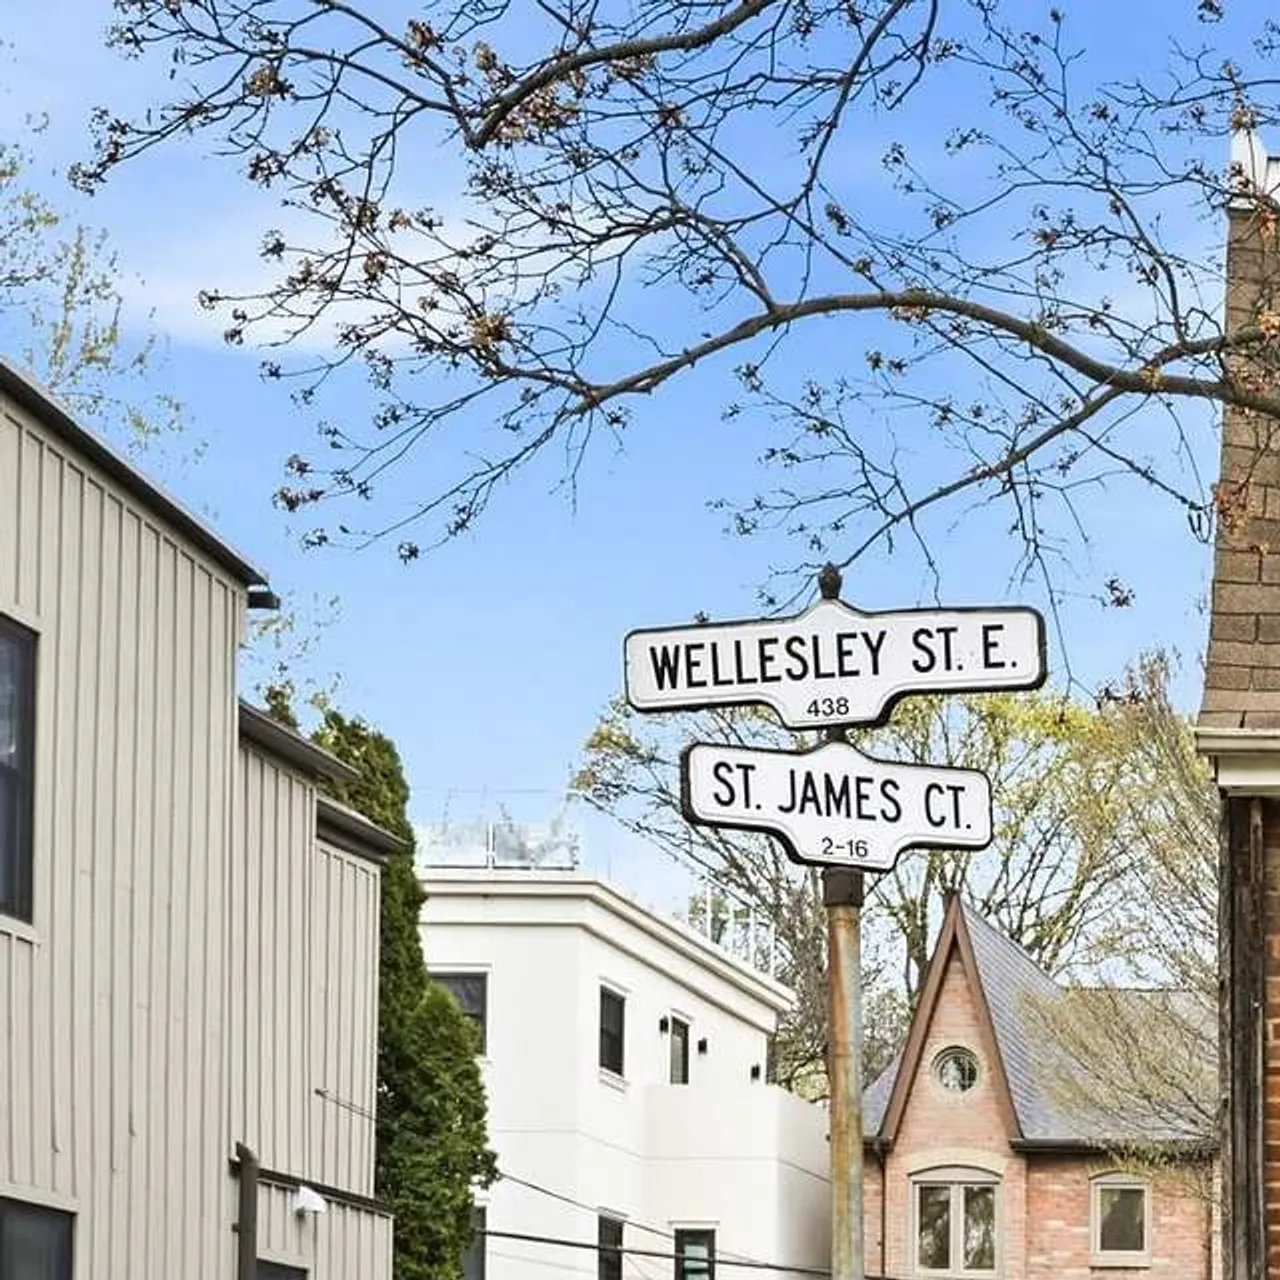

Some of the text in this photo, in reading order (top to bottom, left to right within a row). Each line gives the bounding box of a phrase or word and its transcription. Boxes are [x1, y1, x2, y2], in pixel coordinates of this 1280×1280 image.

[649, 624, 1018, 691] WELLESLEY ST. E.
[806, 697, 850, 718] 438
[712, 761, 972, 830] ST. JAMES CT.
[821, 836, 869, 859] 2-16
